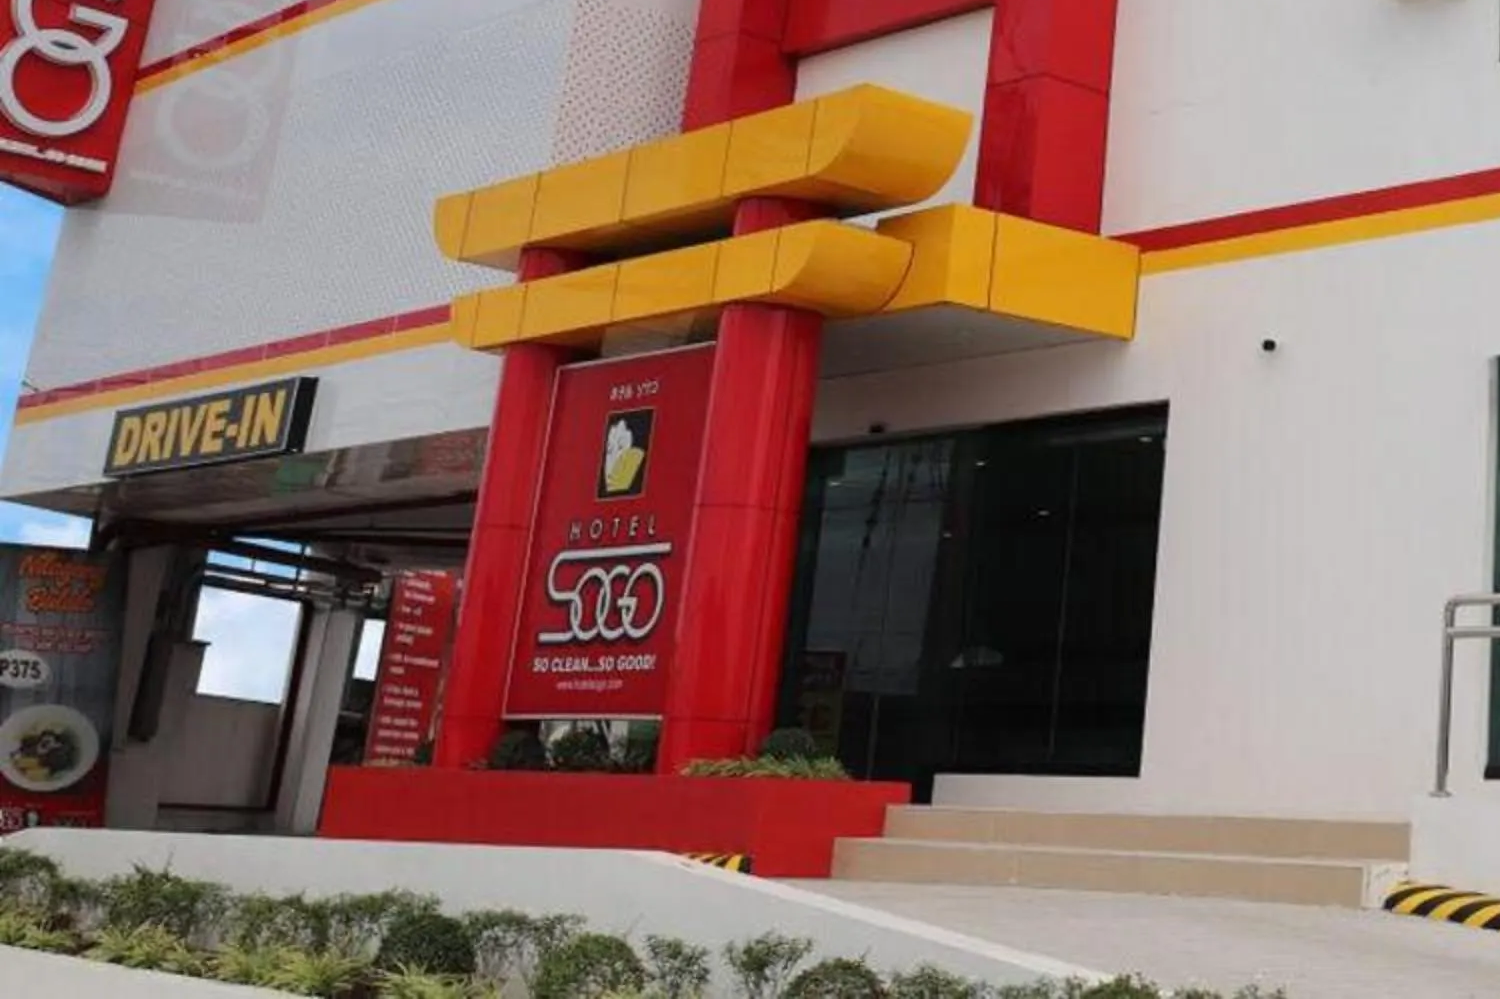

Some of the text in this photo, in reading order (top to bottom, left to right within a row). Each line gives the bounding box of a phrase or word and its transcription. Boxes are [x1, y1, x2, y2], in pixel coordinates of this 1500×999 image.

[112, 388, 287, 467] DRIVE-IN
[569, 515, 657, 540] HOTEL
[537, 542, 672, 642] SOGO
[532, 656, 549, 674] SO
